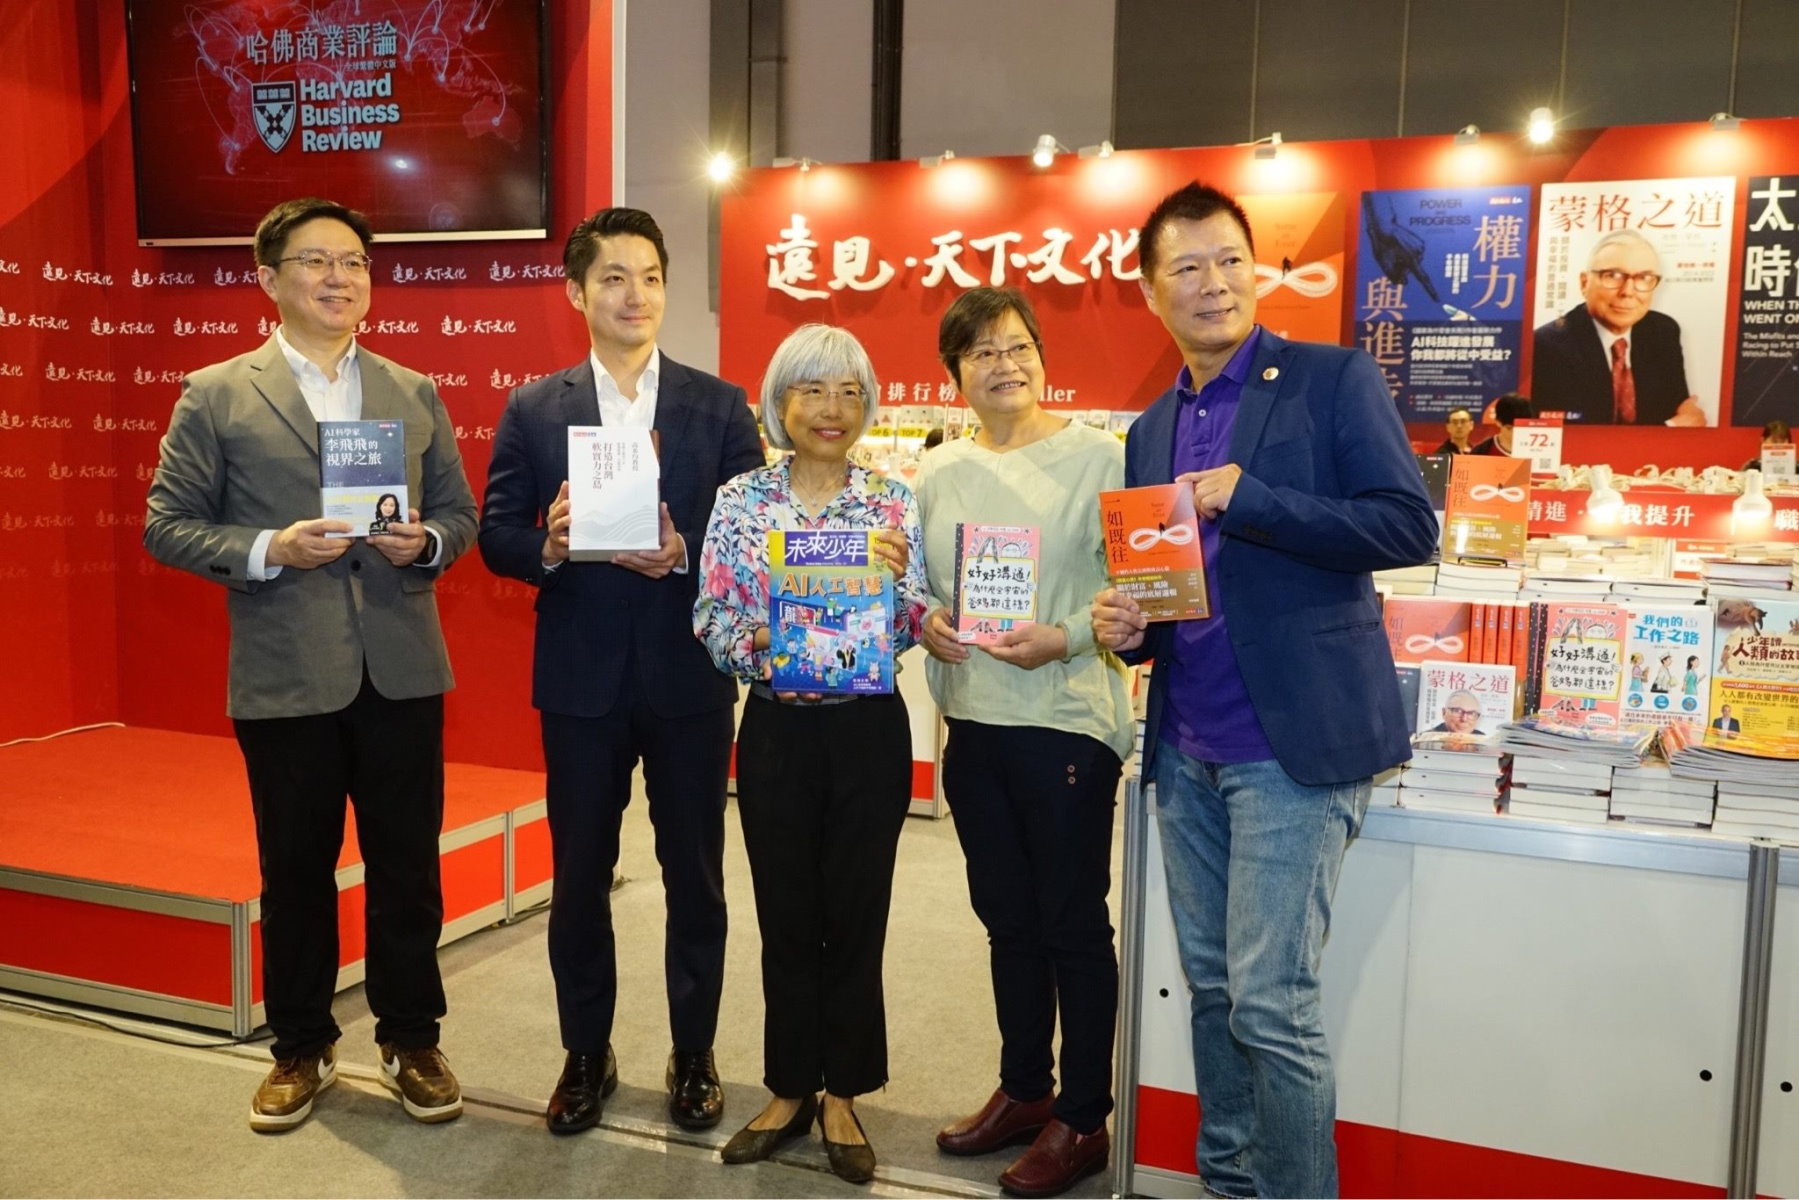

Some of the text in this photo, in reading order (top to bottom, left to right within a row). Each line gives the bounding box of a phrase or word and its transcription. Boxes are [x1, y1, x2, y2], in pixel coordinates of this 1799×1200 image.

[246, 20, 397, 65] 哈佛商業評論
[300, 72, 392, 101] Harvard
[301, 100, 400, 127] Business
[302, 126, 382, 152] Review
[1420, 199, 1462, 209] POWER
[1549, 190, 1725, 233] 蒙格之道
[1409, 215, 1472, 226] PROGRESS
[1472, 214, 1524, 309] 權力
[1744, 300, 1785, 310] WHEN
[1743, 314, 1782, 324] WENT
[325, 437, 378, 452] 李飛飛的
[1529, 433, 1549, 447] 72
[326, 451, 382, 467] 視界之旅
[784, 531, 868, 563] 未來少年
[778, 573, 883, 598] AI人工智慧
[1643, 614, 1684, 628] 我們的
[1633, 624, 1700, 645] 工作之路
[1428, 669, 1510, 694] 蒙格之道
